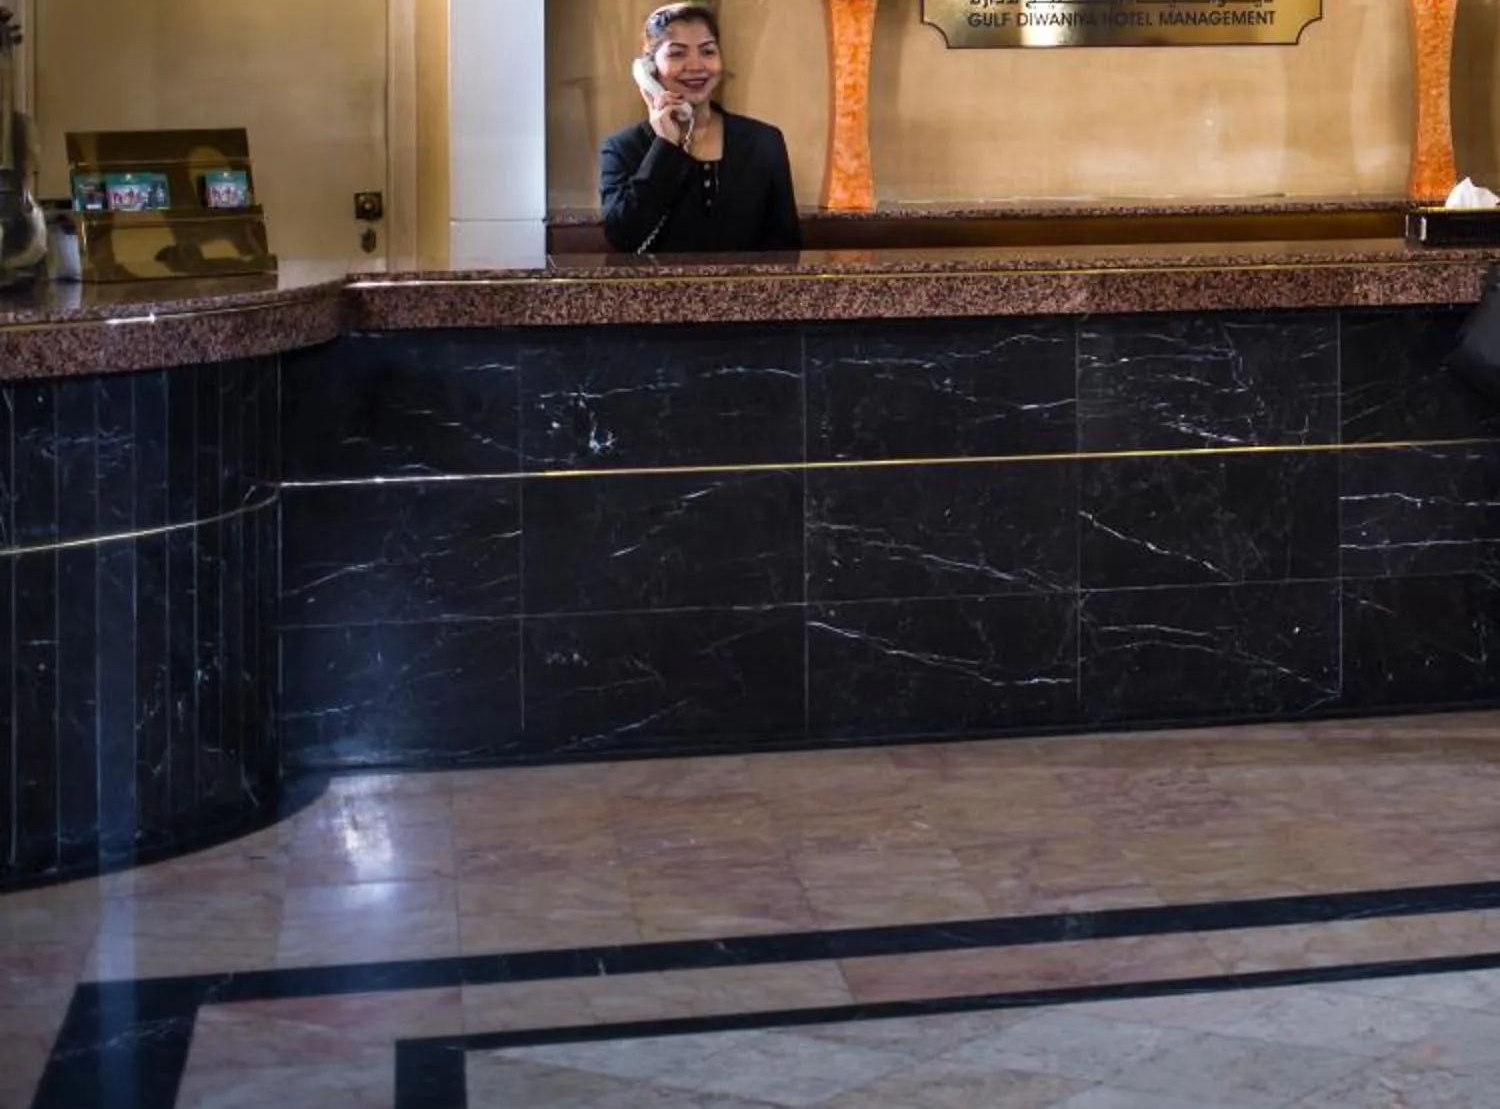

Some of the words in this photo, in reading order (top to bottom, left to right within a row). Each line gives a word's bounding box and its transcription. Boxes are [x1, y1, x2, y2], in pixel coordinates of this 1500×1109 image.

[967, 12, 1012, 28] GULF
[1103, 10, 1152, 27] HOTEL
[1158, 9, 1276, 26] MANAGEMENT
